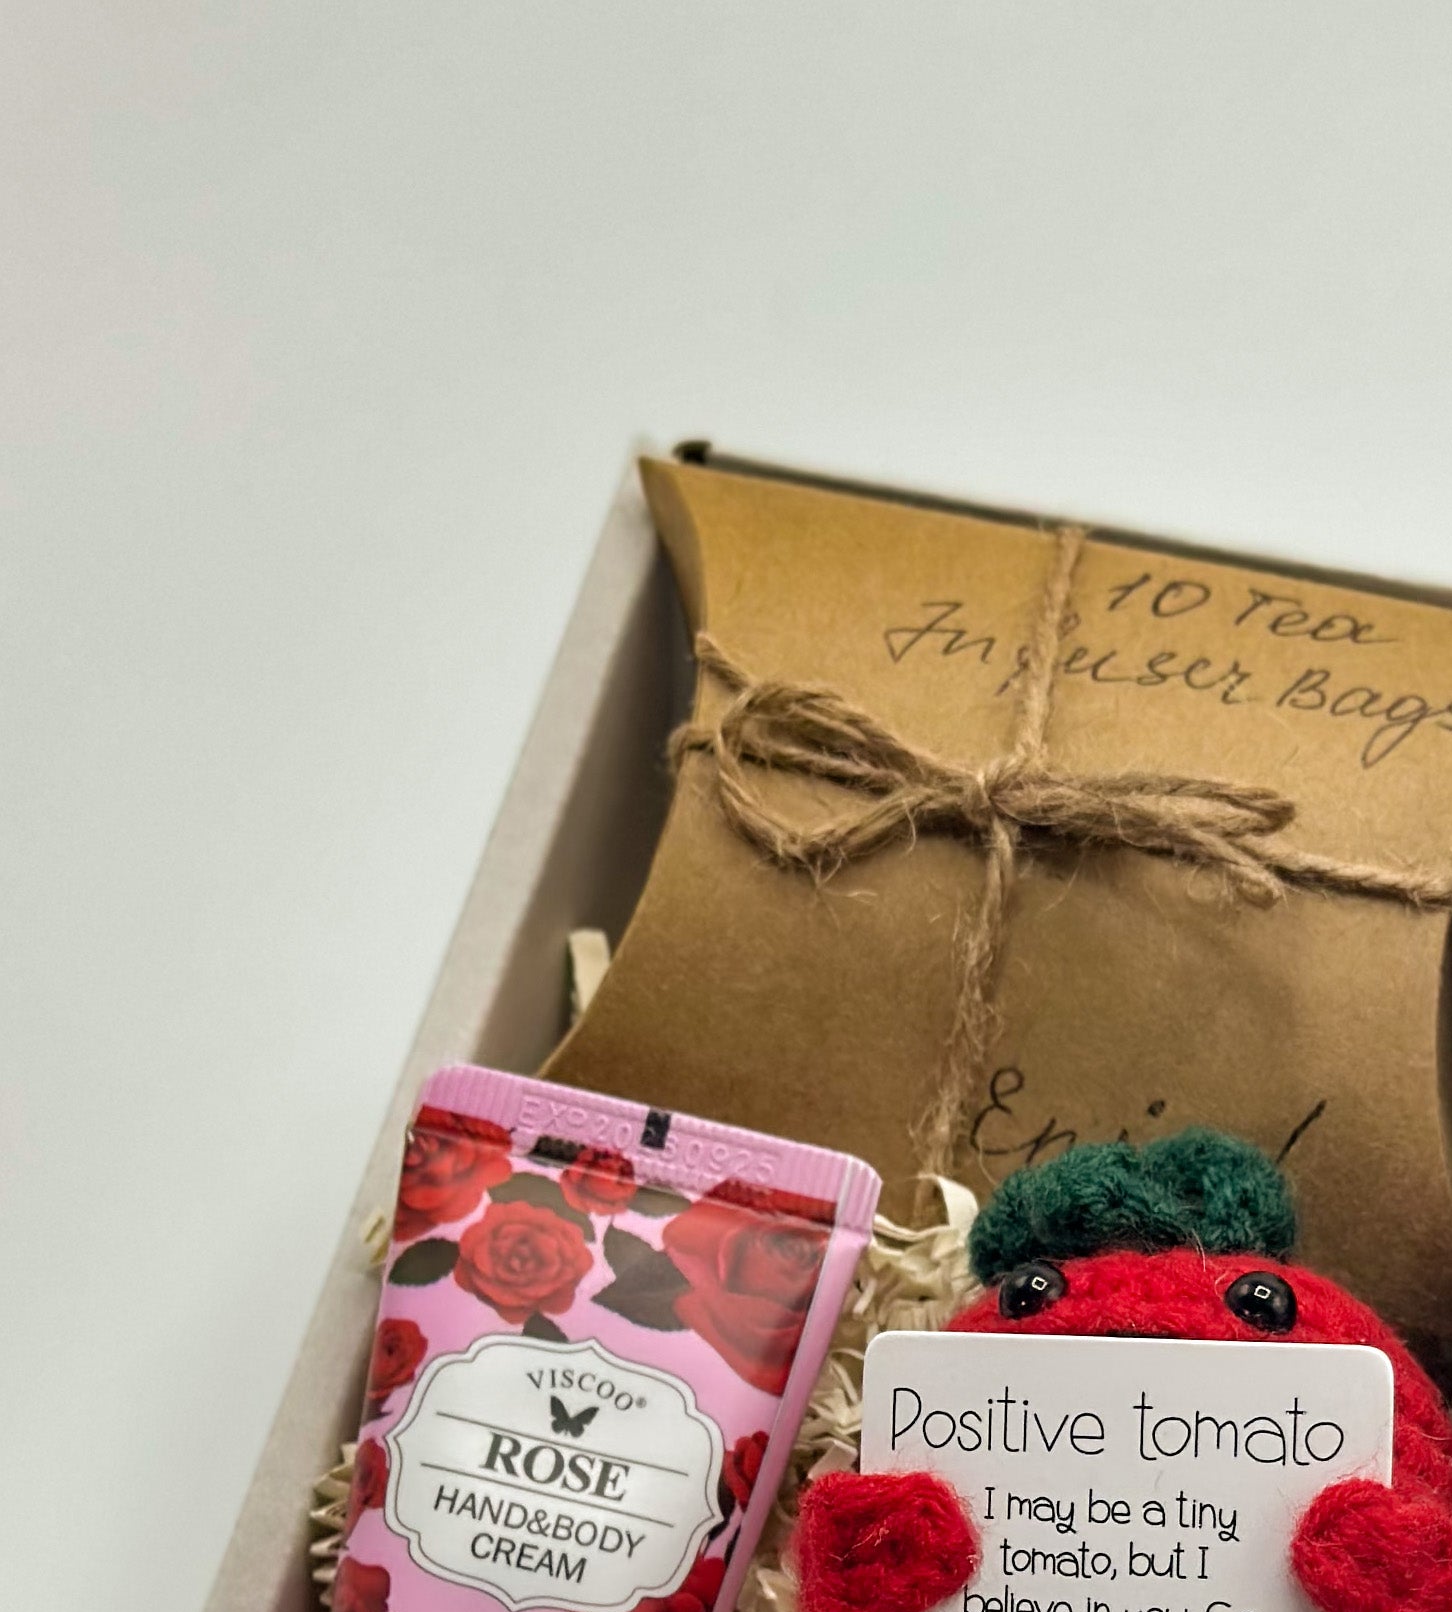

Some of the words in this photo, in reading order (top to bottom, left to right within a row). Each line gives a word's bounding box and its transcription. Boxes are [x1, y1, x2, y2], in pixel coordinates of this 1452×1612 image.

[1108, 572, 1211, 619] 10
[1235, 586, 1400, 645] Tea
[889, 1386, 1106, 1456] Positive
[1132, 1391, 1345, 1466] tomato
[478, 1431, 631, 1503] ROSE
[433, 1485, 646, 1559] HAND&BODY
[983, 1486, 997, 1521] I
[1006, 1493, 1077, 1535] may
[1087, 1488, 1132, 1525] be
[1142, 1501, 1166, 1528] a
[1174, 1490, 1240, 1542] tiny
[470, 1532, 588, 1584] CREAM
[999, 1538, 1118, 1581] tomato,
[1128, 1541, 1187, 1580] but
[1196, 1546, 1210, 1580] I
